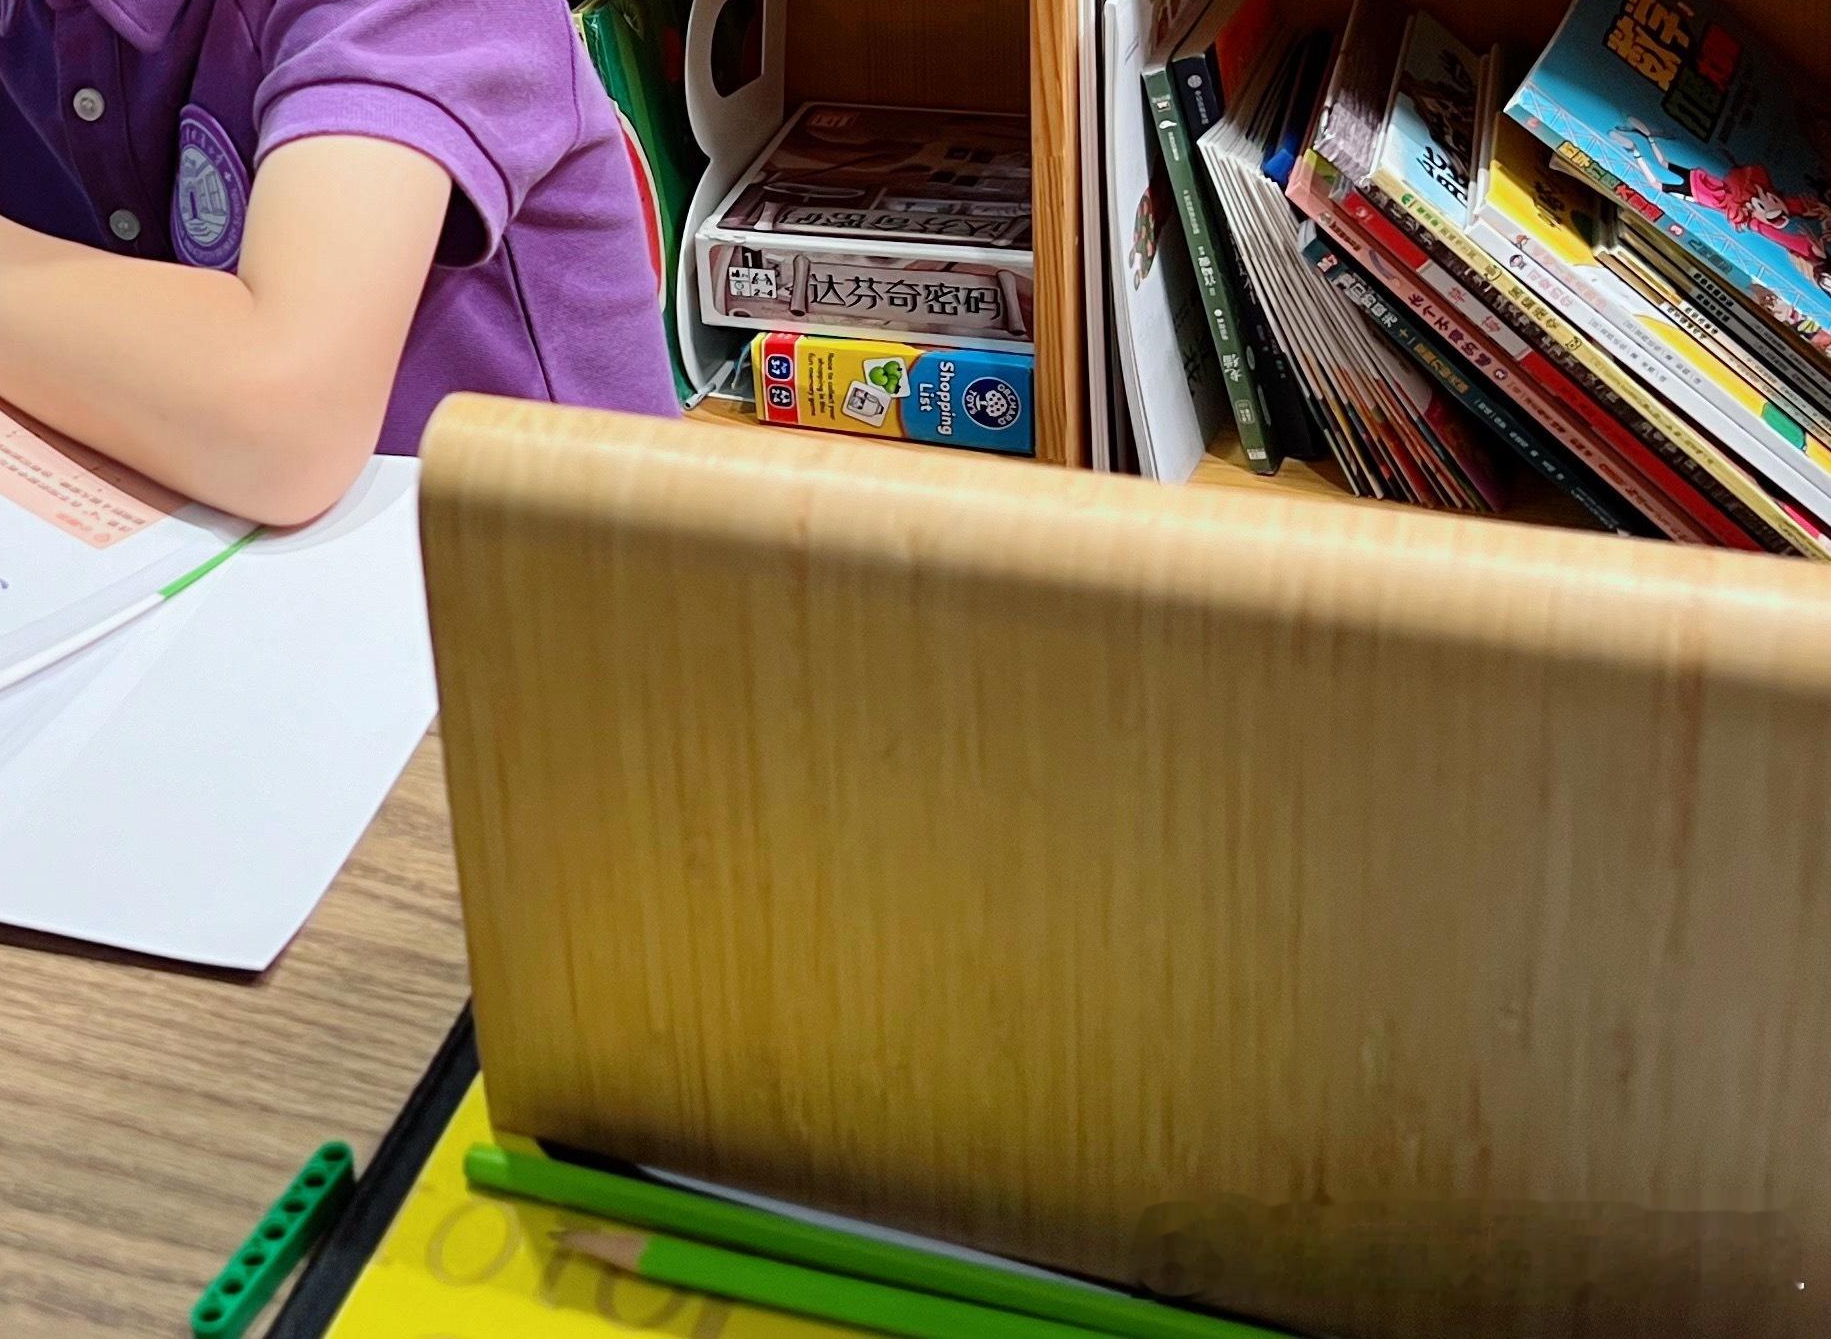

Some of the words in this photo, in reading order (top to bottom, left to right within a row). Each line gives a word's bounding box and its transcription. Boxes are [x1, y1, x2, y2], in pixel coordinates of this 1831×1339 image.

[809, 272, 1003, 321] 达芬奇密码
[770, 359, 780, 375] 3-7
[918, 383, 934, 413] List
[937, 360, 955, 436] Shopping
[964, 388, 976, 416] TOYS
[996, 383, 1020, 426] ORCHARD
